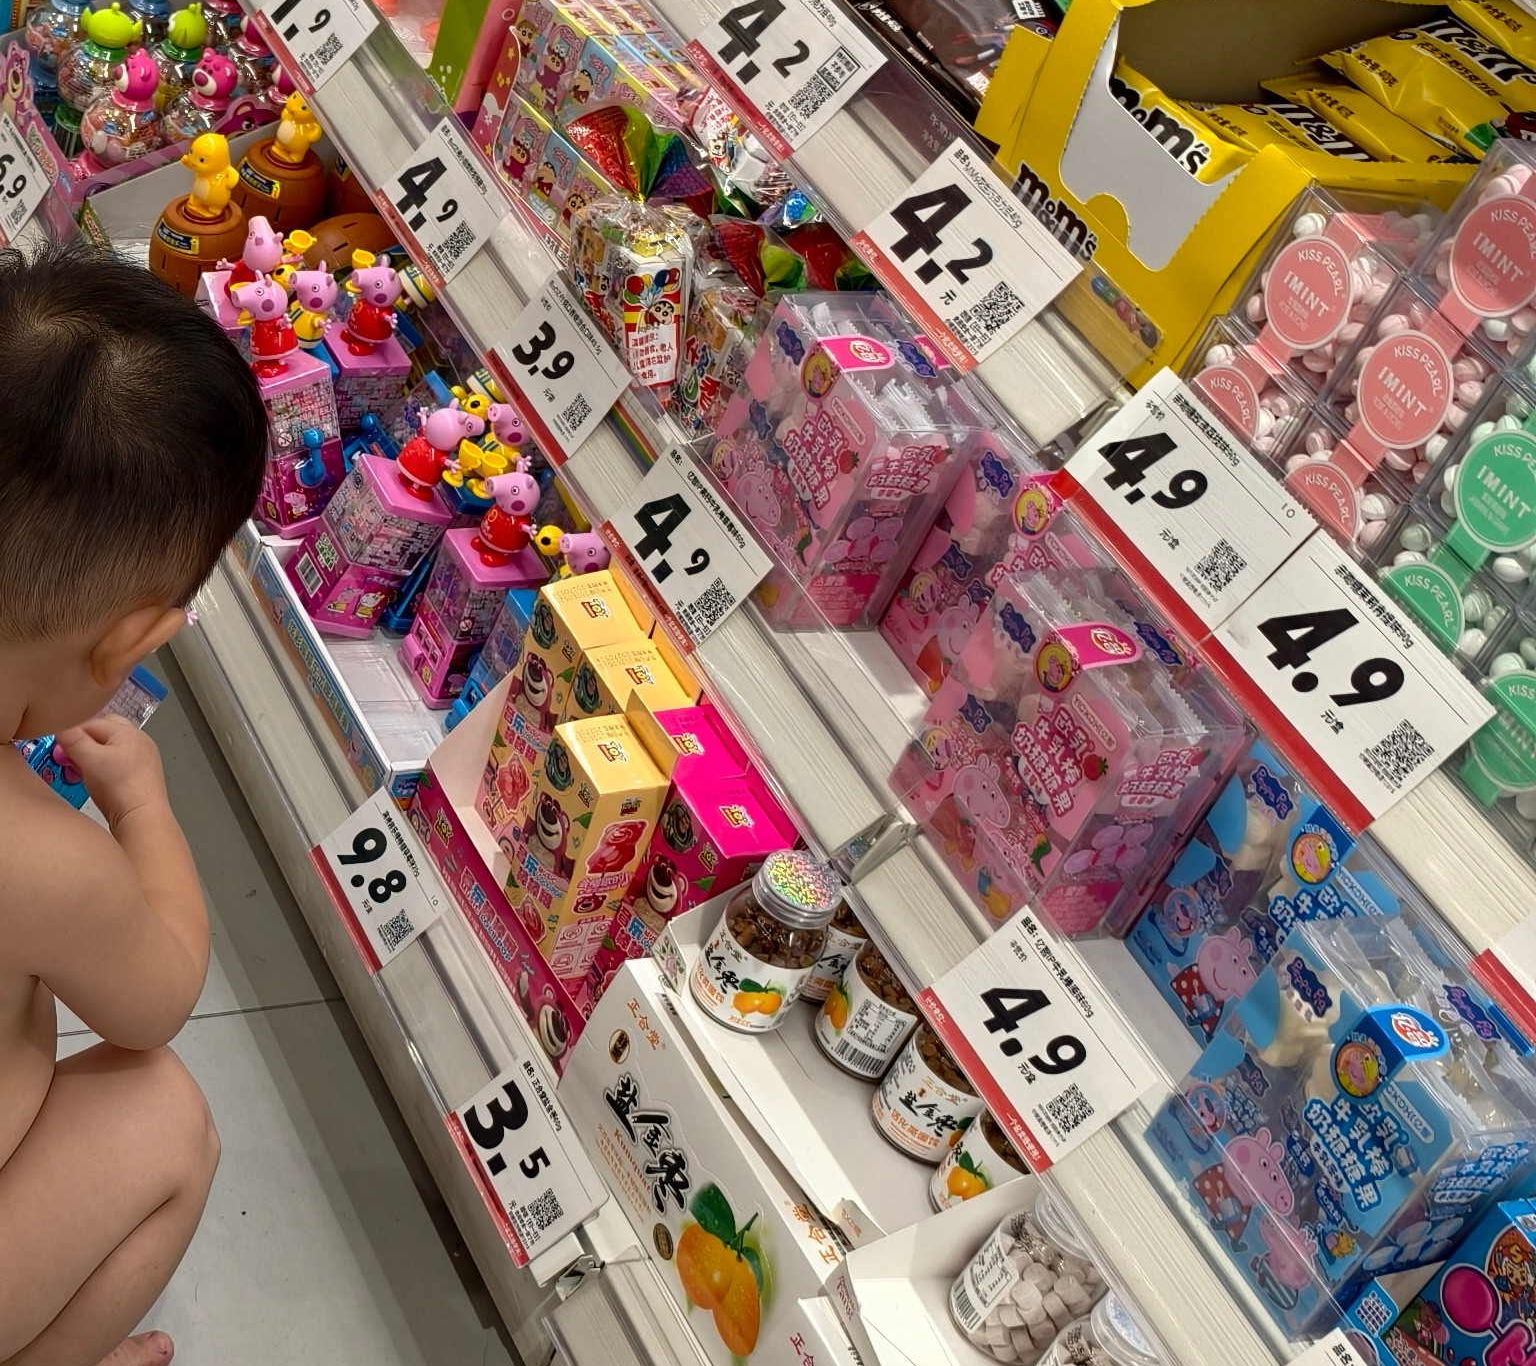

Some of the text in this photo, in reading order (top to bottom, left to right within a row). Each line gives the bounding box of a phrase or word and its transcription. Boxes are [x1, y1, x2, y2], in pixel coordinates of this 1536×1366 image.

[396, 157, 458, 232] 4.9
[1491, 209, 1518, 223] KISS
[890, 184, 993, 285] 4.2
[940, 290, 956, 305] 元
[1298, 249, 1345, 296] KISS PEARL
[512, 321, 574, 379] 3.9
[1394, 345, 1443, 397] KISS PEARL
[1209, 376, 1252, 431] KISS PEARL
[1098, 433, 1207, 509] 4.9
[1493, 444, 1523, 459] KISS
[1305, 473, 1350, 524] KISS PEARL
[634, 494, 710, 583] 4.9
[1404, 573, 1453, 629] KISS PEARL
[1257, 608, 1404, 706] 4.9
[337, 828, 406, 903] 9.8
[980, 988, 1086, 1074] 4.9
[464, 1080, 550, 1178] 3.5
